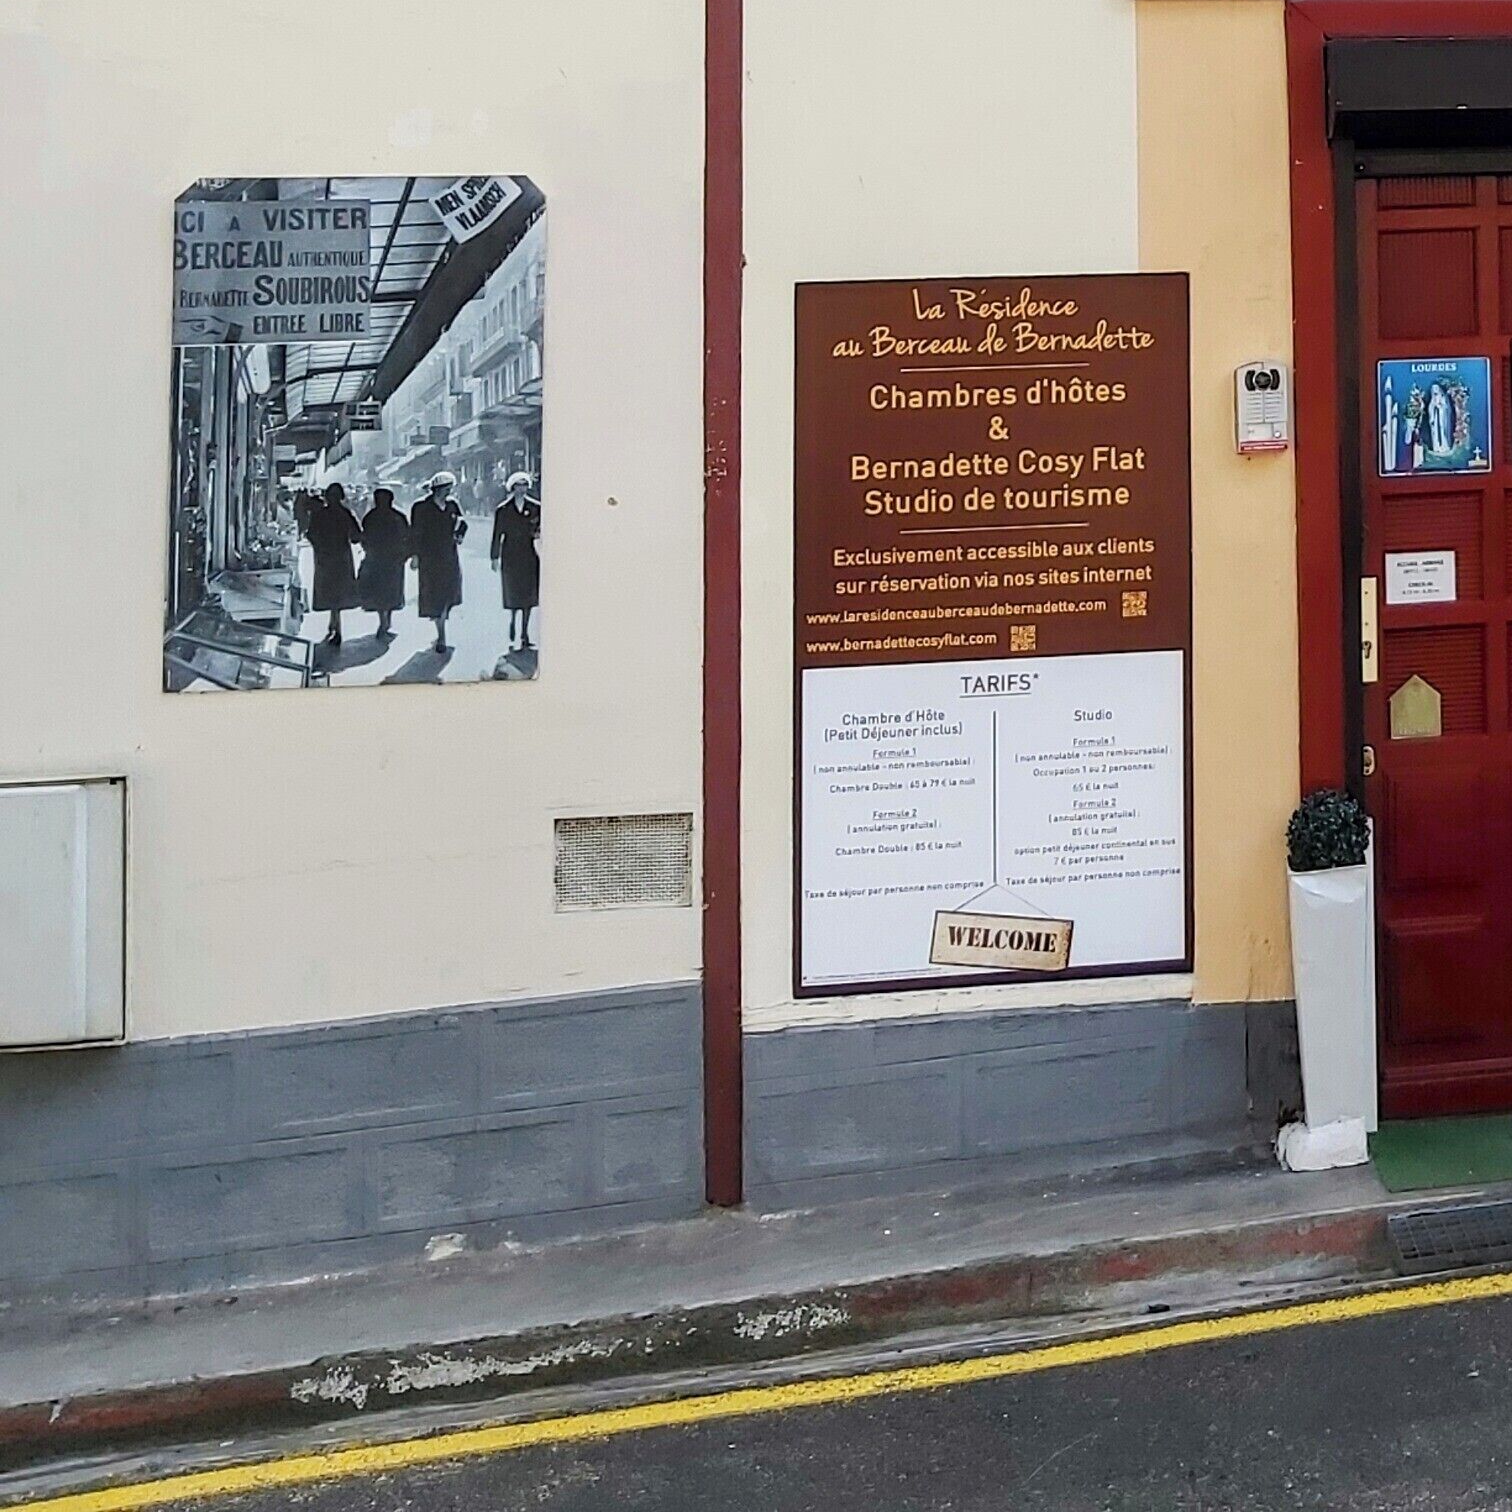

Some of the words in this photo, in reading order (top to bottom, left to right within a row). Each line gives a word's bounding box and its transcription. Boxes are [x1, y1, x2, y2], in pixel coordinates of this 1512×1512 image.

[229, 216, 241, 231] A
[263, 207, 367, 231] VISITER
[174, 239, 283, 270] BERCEAU
[287, 250, 366, 268] AUTHENTIQUE
[253, 275, 370, 306] SOUBIROUS
[913, 288, 946, 321] La
[949, 287, 1079, 321] Résidence
[253, 314, 306, 335] ENTREE
[320, 313, 365, 333] LIBRE
[833, 338, 863, 358] au
[868, 325, 972, 358] Berceau
[977, 324, 1007, 354] de
[1011, 320, 1155, 355] Bernadette
[1411, 362, 1457, 373] LOURDES
[870, 382, 1017, 409] Chambres
[1026, 377, 1127, 405] d'hôtes
[988, 416, 1009, 440] &
[851, 452, 1009, 481] Bernadette
[1018, 449, 1084, 479] Cosy
[1092, 446, 1145, 471] Flat
[864, 489, 954, 515] Studio
[964, 487, 995, 511] de
[1003, 484, 1130, 510] tourisme
[833, 545, 963, 567] Exclusivement
[966, 540, 1058, 561] accessible
[1062, 541, 1094, 557] aux
[1097, 538, 1155, 554] clients
[836, 580, 867, 595] sur
[870, 574, 970, 593] réservation
[974, 573, 999, 588] via
[1003, 572, 1035, 587] nos
[1038, 568, 1080, 585] sites
[1083, 565, 1152, 583] internet
[806, 632, 997, 653] www.bernadettecosyflat.com
[842, 713, 900, 726] Chambre
[905, 709, 945, 722] d'Hôte
[1074, 710, 1113, 721] Studio
[824, 728, 858, 742] (Petit
[861, 726, 918, 742] Déjeuner
[1073, 738, 1109, 746] Formule
[1111, 736, 1115, 744] 1
[1033, 768, 1080, 776] Occupation
[1102, 765, 1106, 773] 2
[830, 785, 869, 793] Chambre
[912, 809, 917, 817] 2
[1111, 798, 1116, 806] 2
[835, 847, 875, 856] Chambre
[878, 845, 908, 853] Double
[948, 926, 1057, 953] WELCOME
